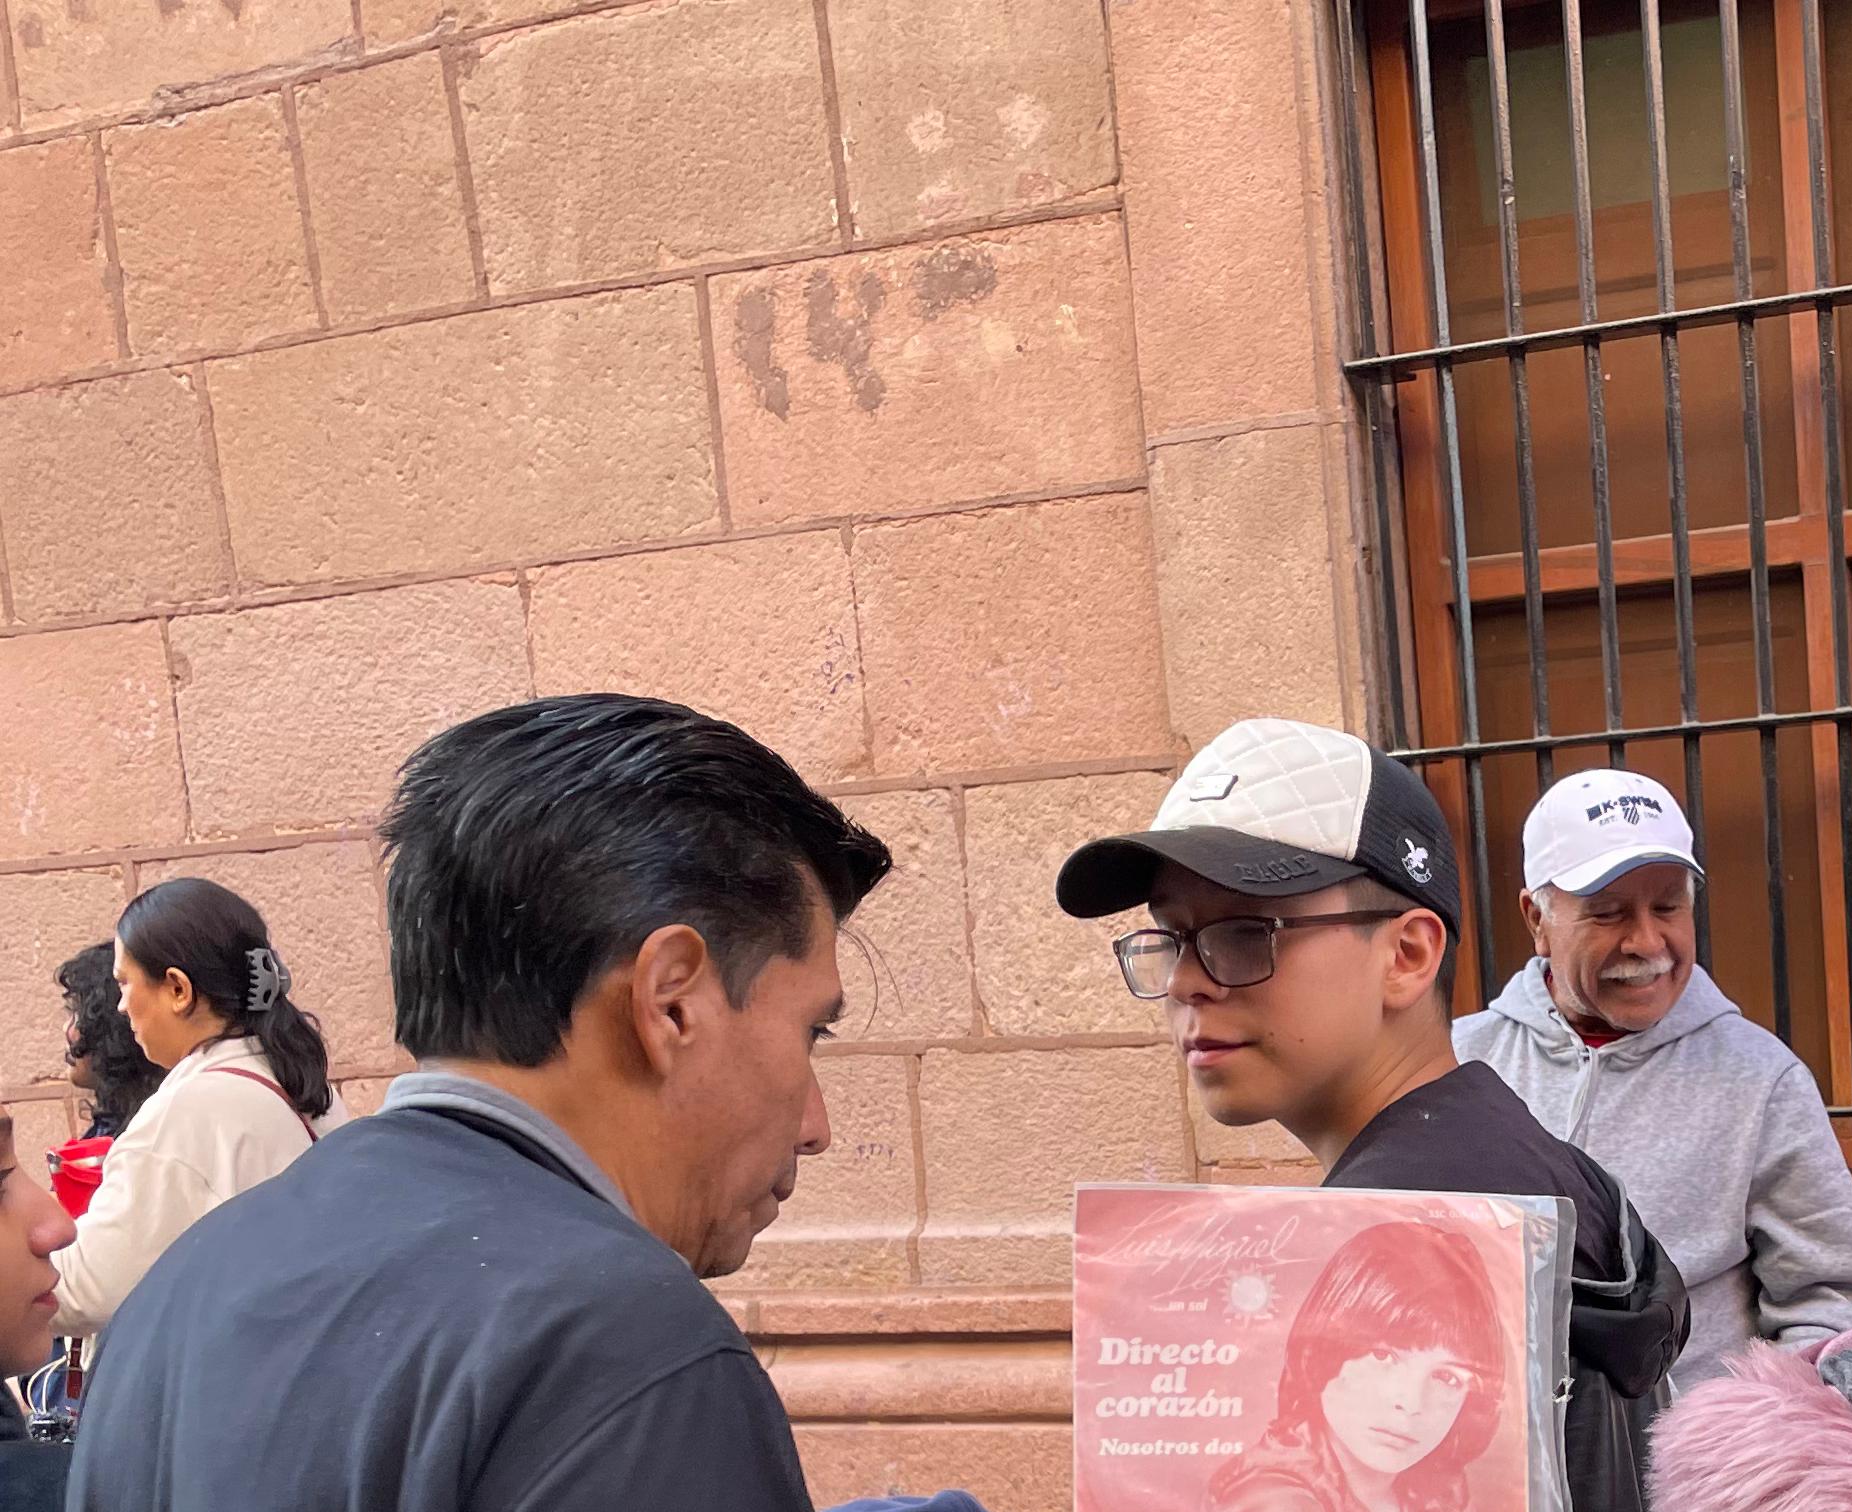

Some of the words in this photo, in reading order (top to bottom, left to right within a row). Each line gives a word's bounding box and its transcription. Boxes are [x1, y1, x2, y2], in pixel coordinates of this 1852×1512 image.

[1232, 854, 1319, 884] EAGLE
[1098, 1337, 1240, 1365] Directo
[1151, 1366, 1187, 1394] al
[1096, 1389, 1243, 1418] corazón
[1099, 1438, 1200, 1456] Nosotros
[1204, 1438, 1243, 1455] dos
